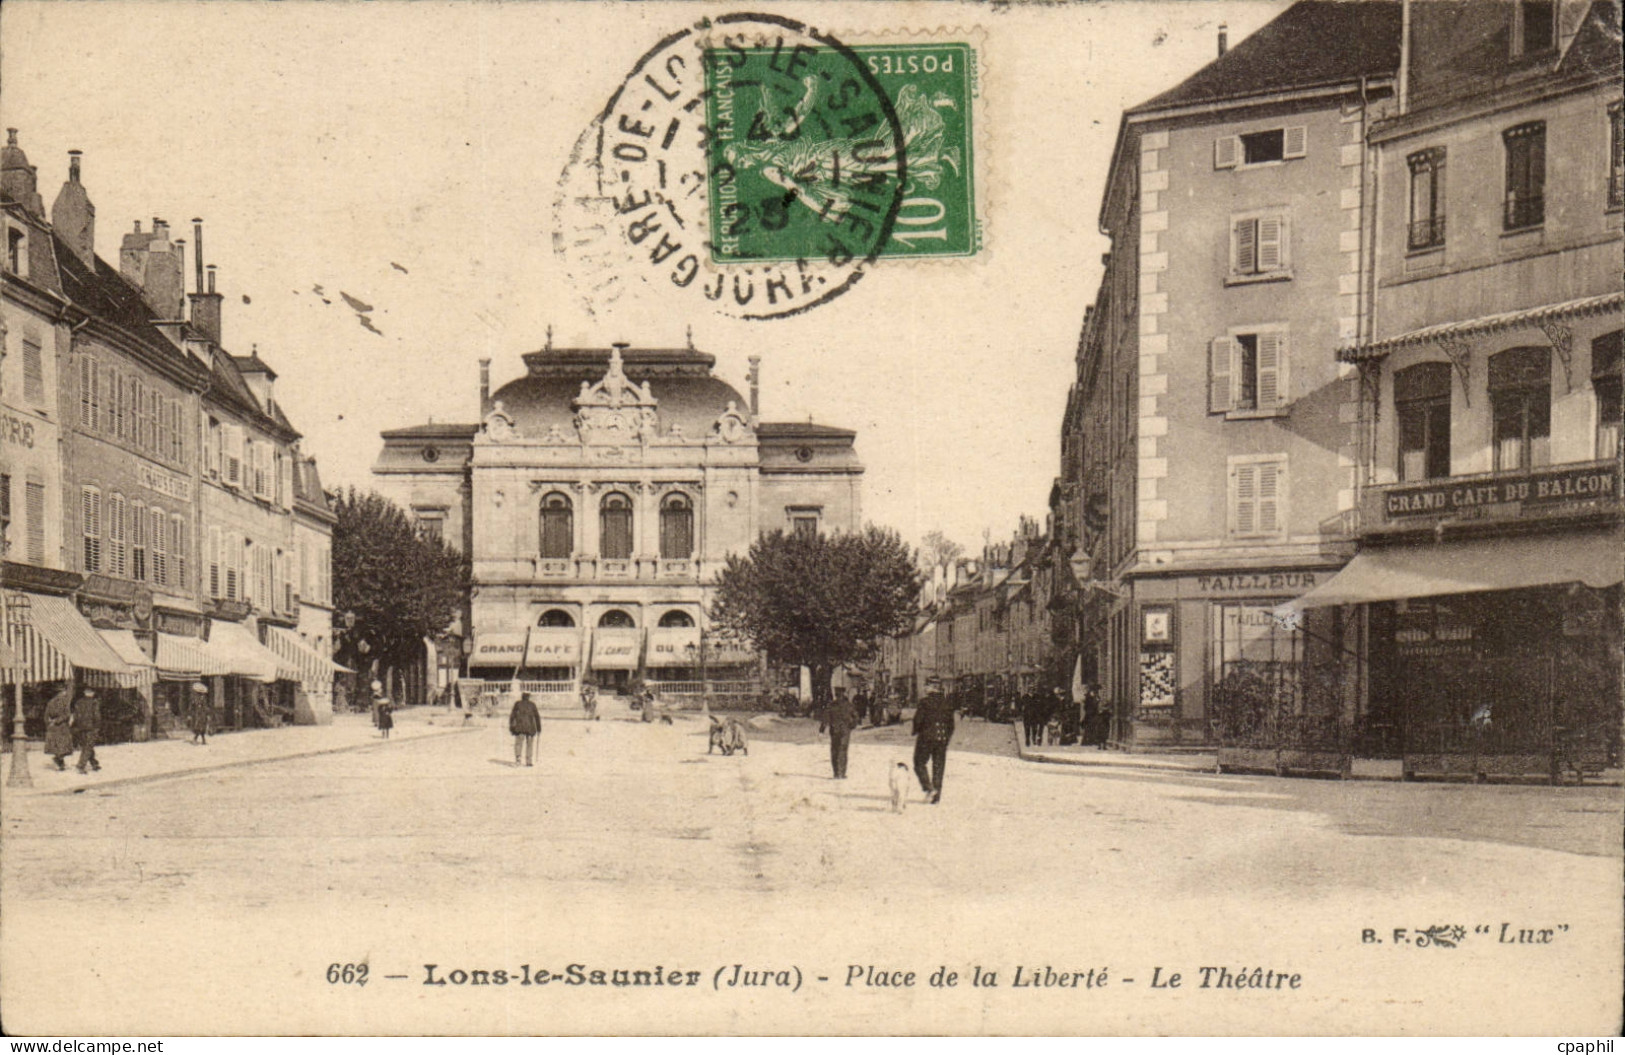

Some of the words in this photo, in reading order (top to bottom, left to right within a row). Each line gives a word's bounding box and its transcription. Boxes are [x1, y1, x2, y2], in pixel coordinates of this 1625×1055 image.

[868, 54, 954, 74] POSTES
[1387, 491, 1446, 513] GRAND
[1505, 481, 1530, 501] DU
[1538, 474, 1613, 497] BALCON
[1198, 573, 1317, 592] TAILLEUR
[479, 644, 525, 654] GRAND
